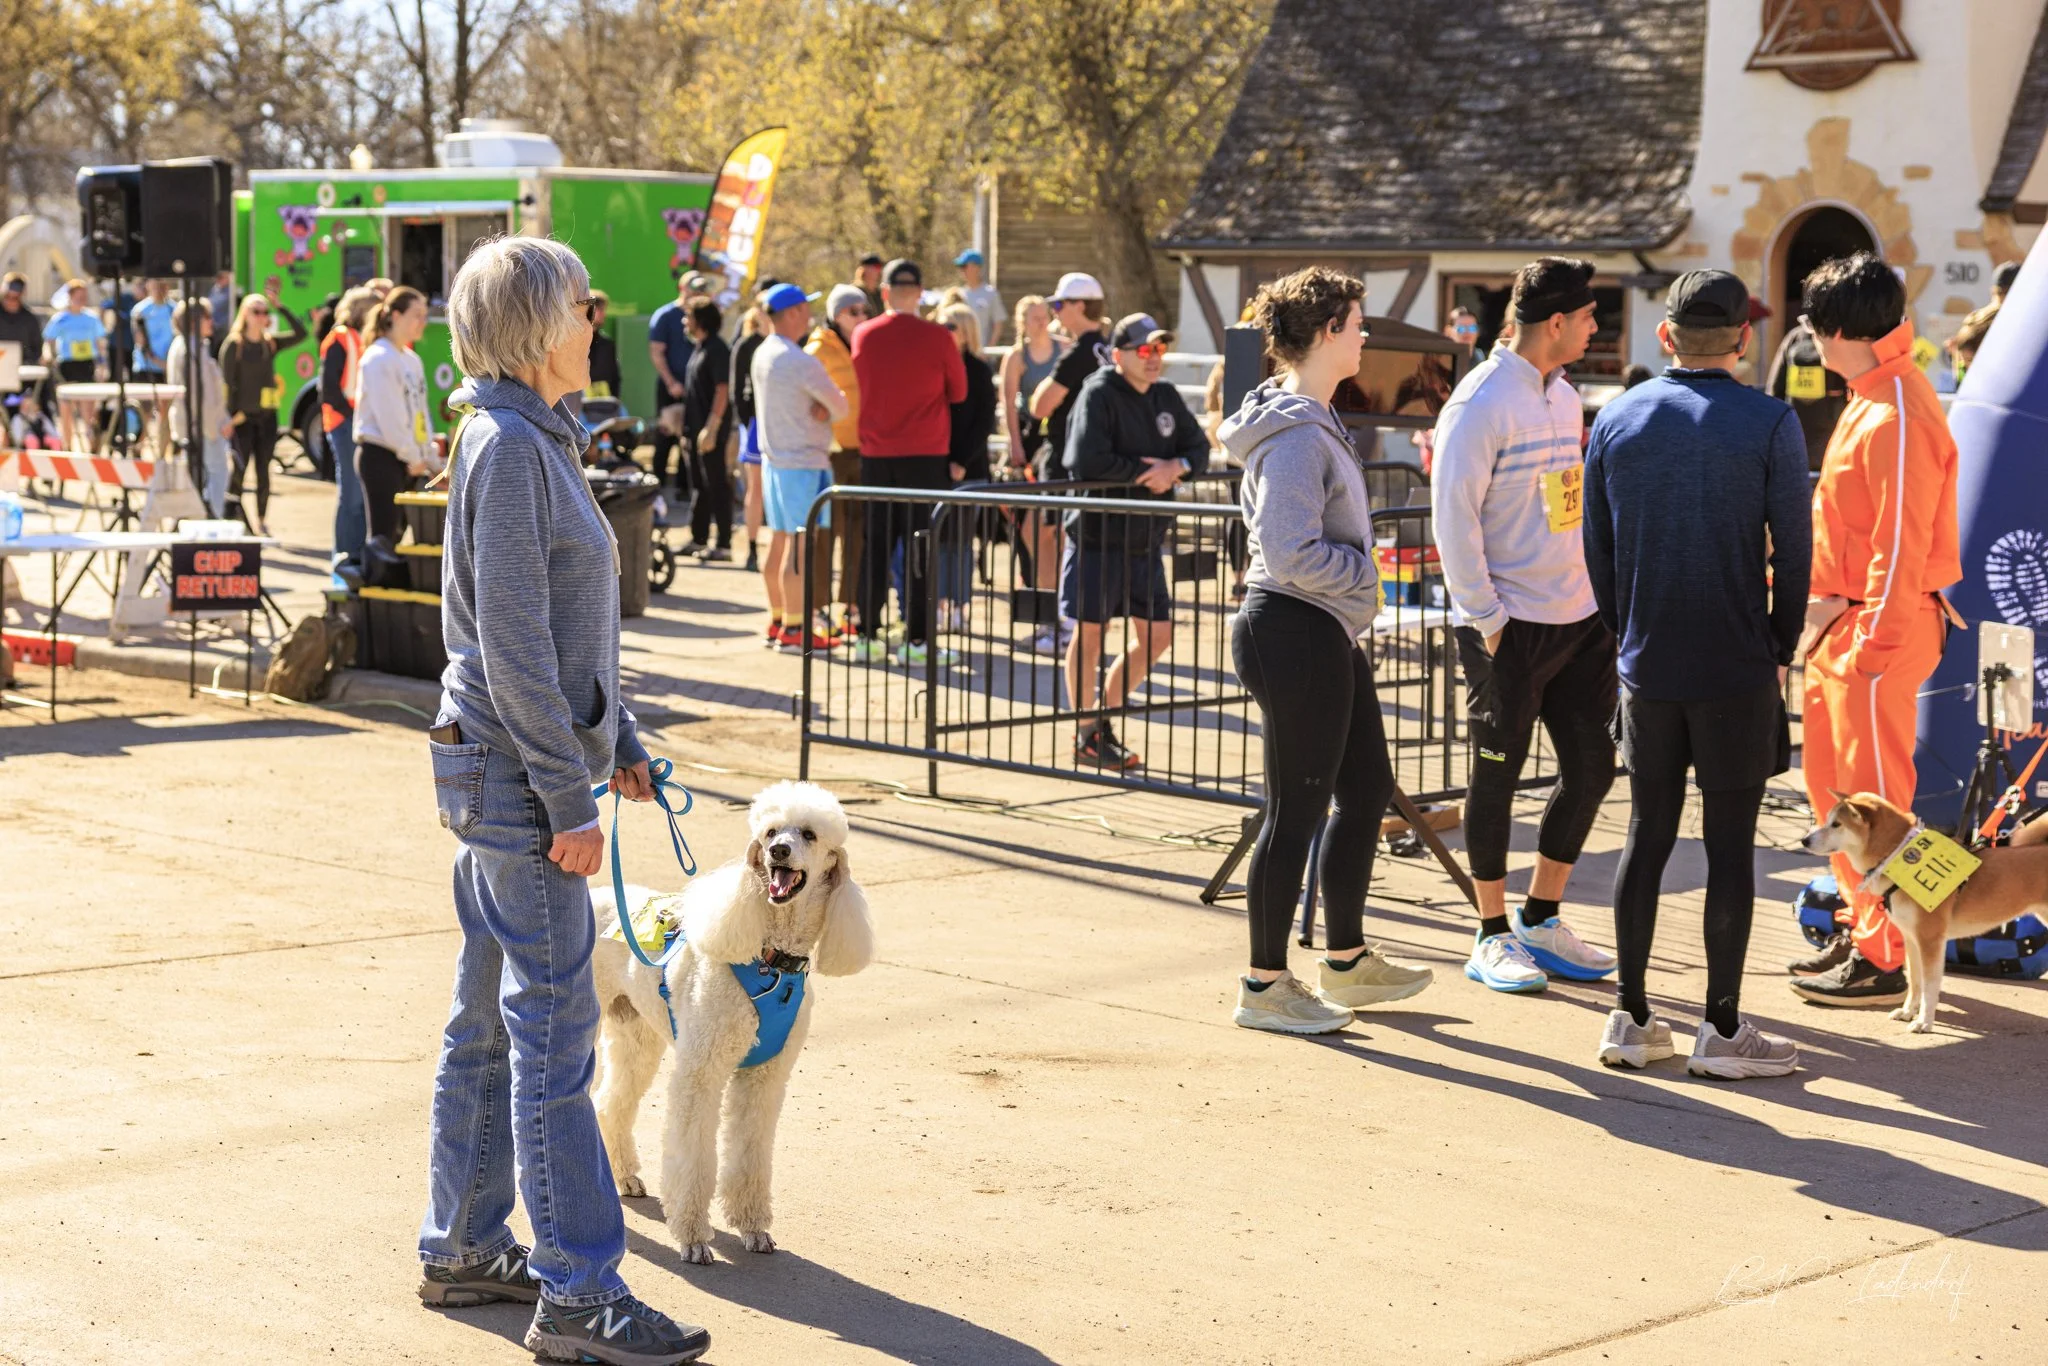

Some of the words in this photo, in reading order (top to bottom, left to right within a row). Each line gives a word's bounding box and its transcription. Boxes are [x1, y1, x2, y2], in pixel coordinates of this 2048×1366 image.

[1944, 261, 1980, 285] 510
[193, 550, 242, 574] CHIP
[176, 574, 258, 599] RETURN
[1479, 747, 1506, 759] POLO
[1914, 854, 1957, 892] Elli
